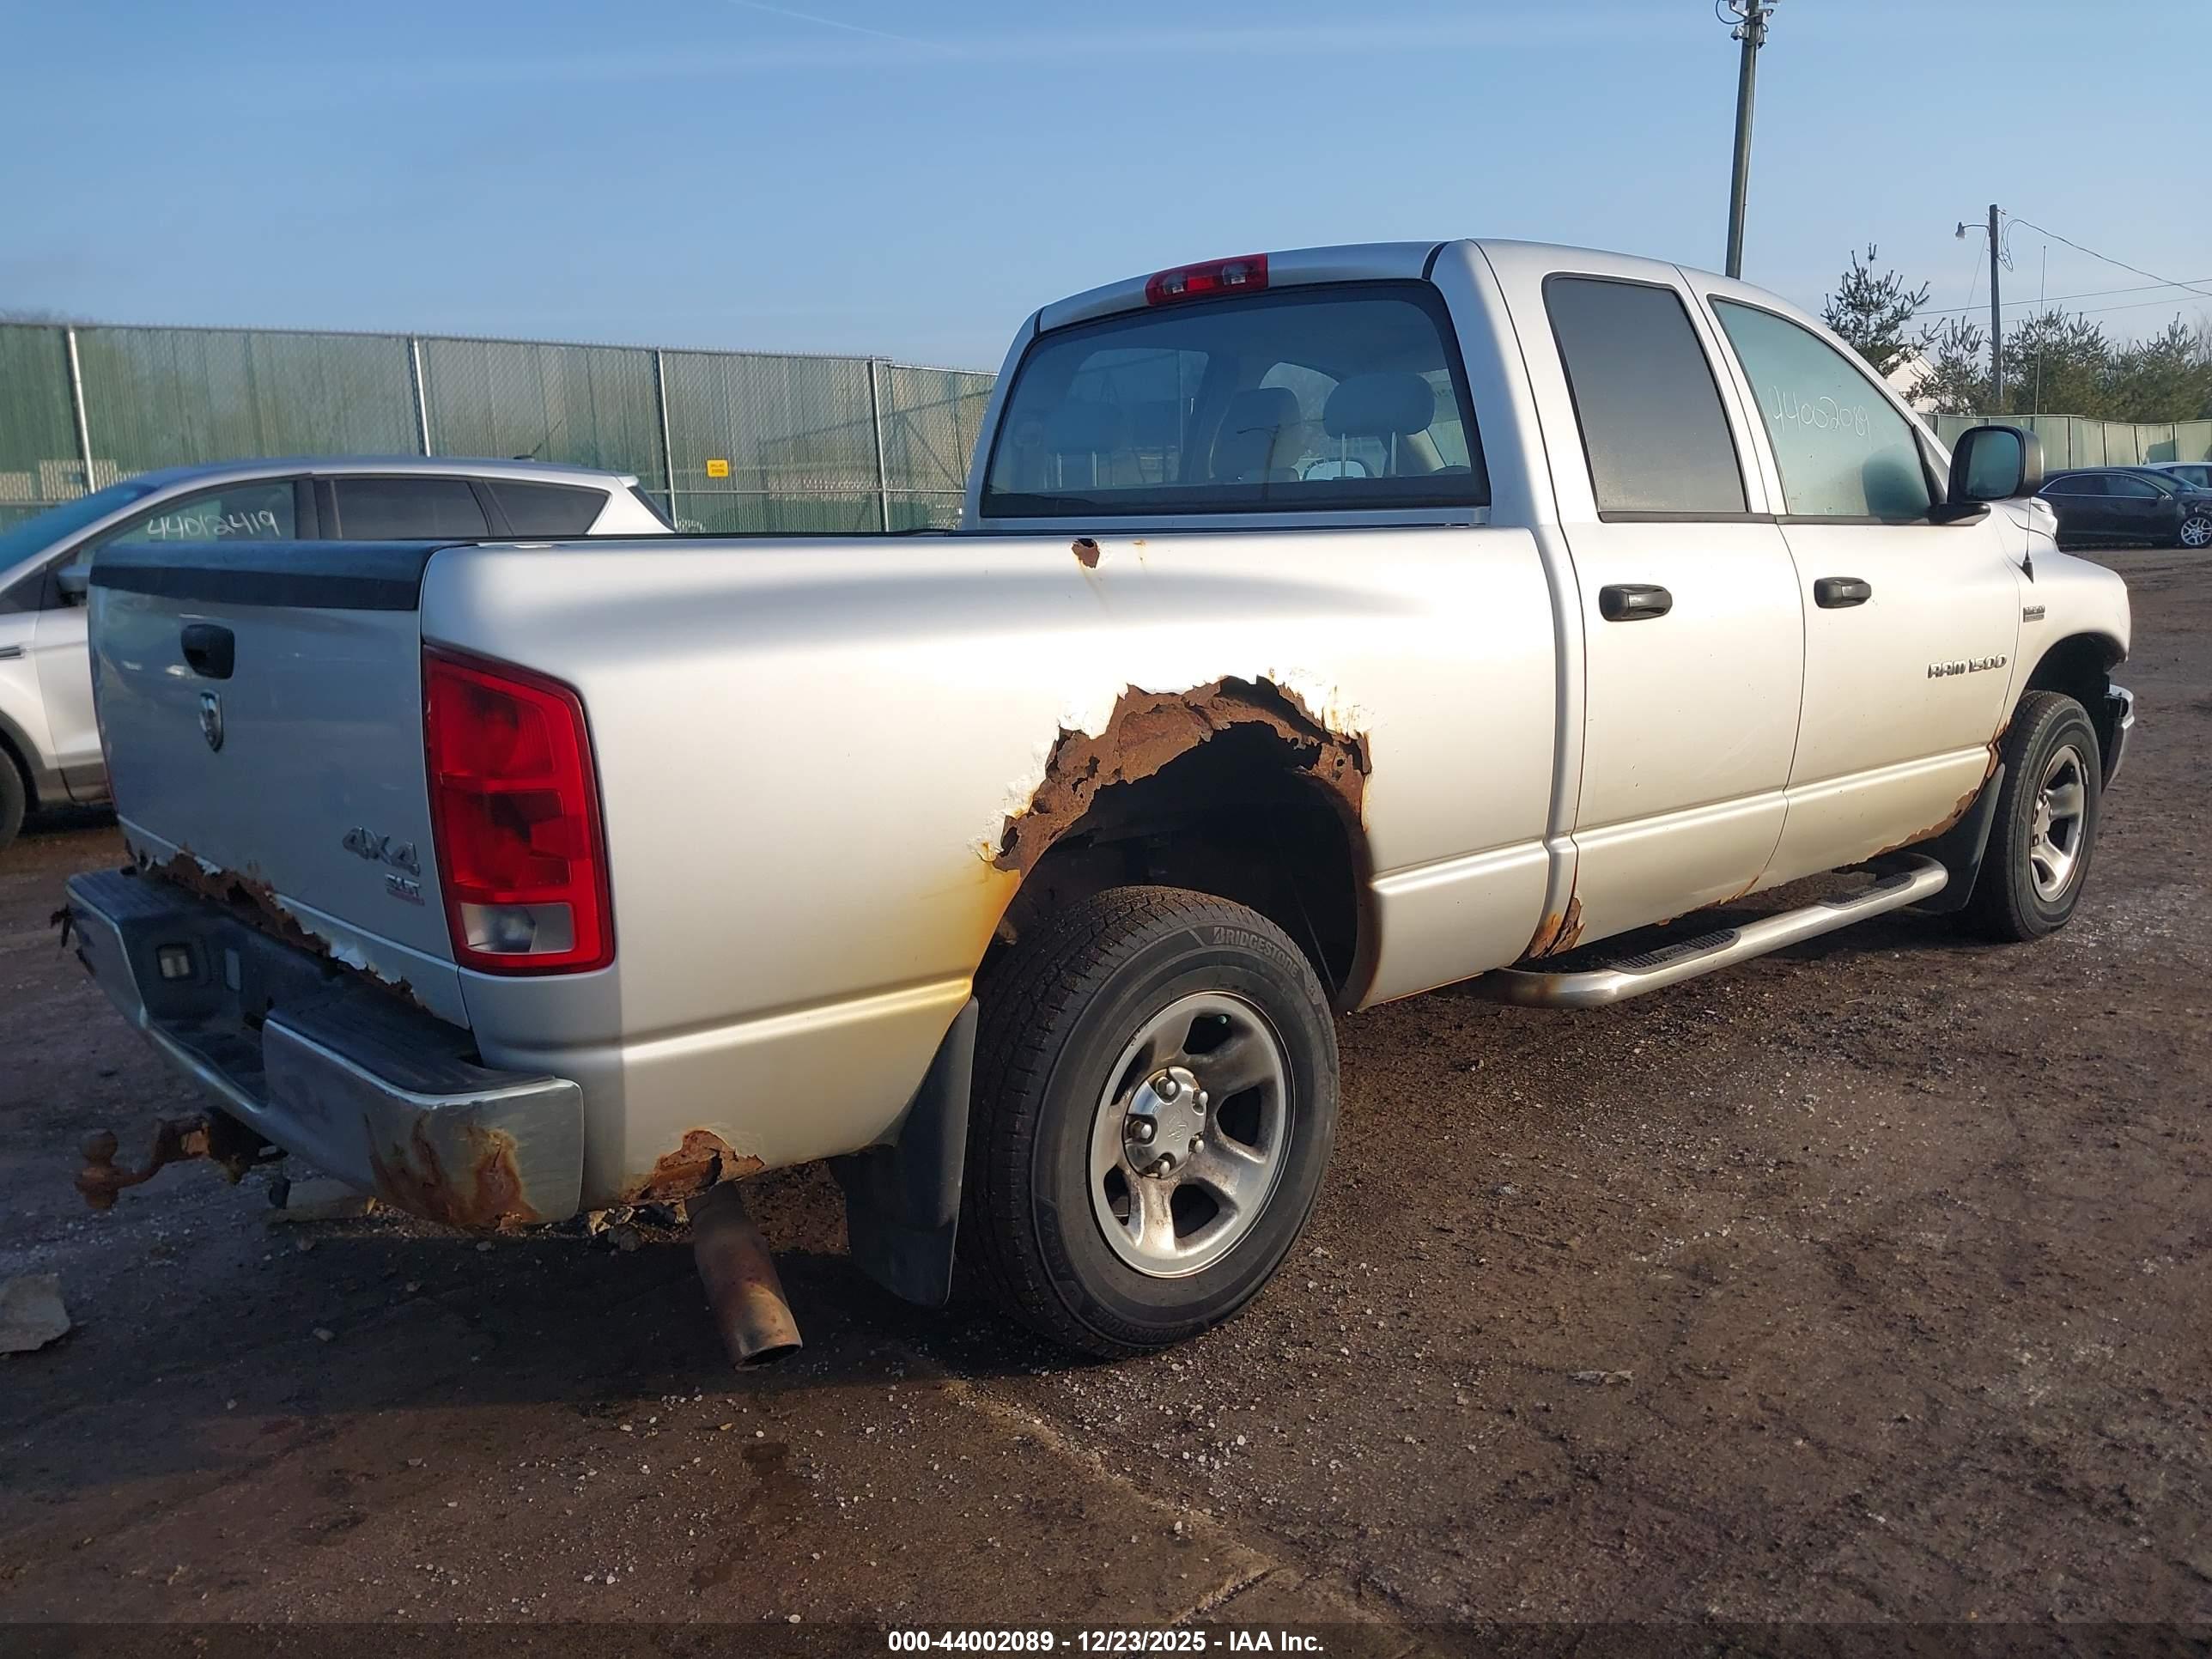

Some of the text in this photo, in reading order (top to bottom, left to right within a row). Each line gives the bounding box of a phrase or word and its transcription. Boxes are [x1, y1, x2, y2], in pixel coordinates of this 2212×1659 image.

[148, 510, 281, 539] 44012419
[1928, 654, 2008, 678] RAM 1500
[1213, 927, 1300, 978] BRIDGESTONE
